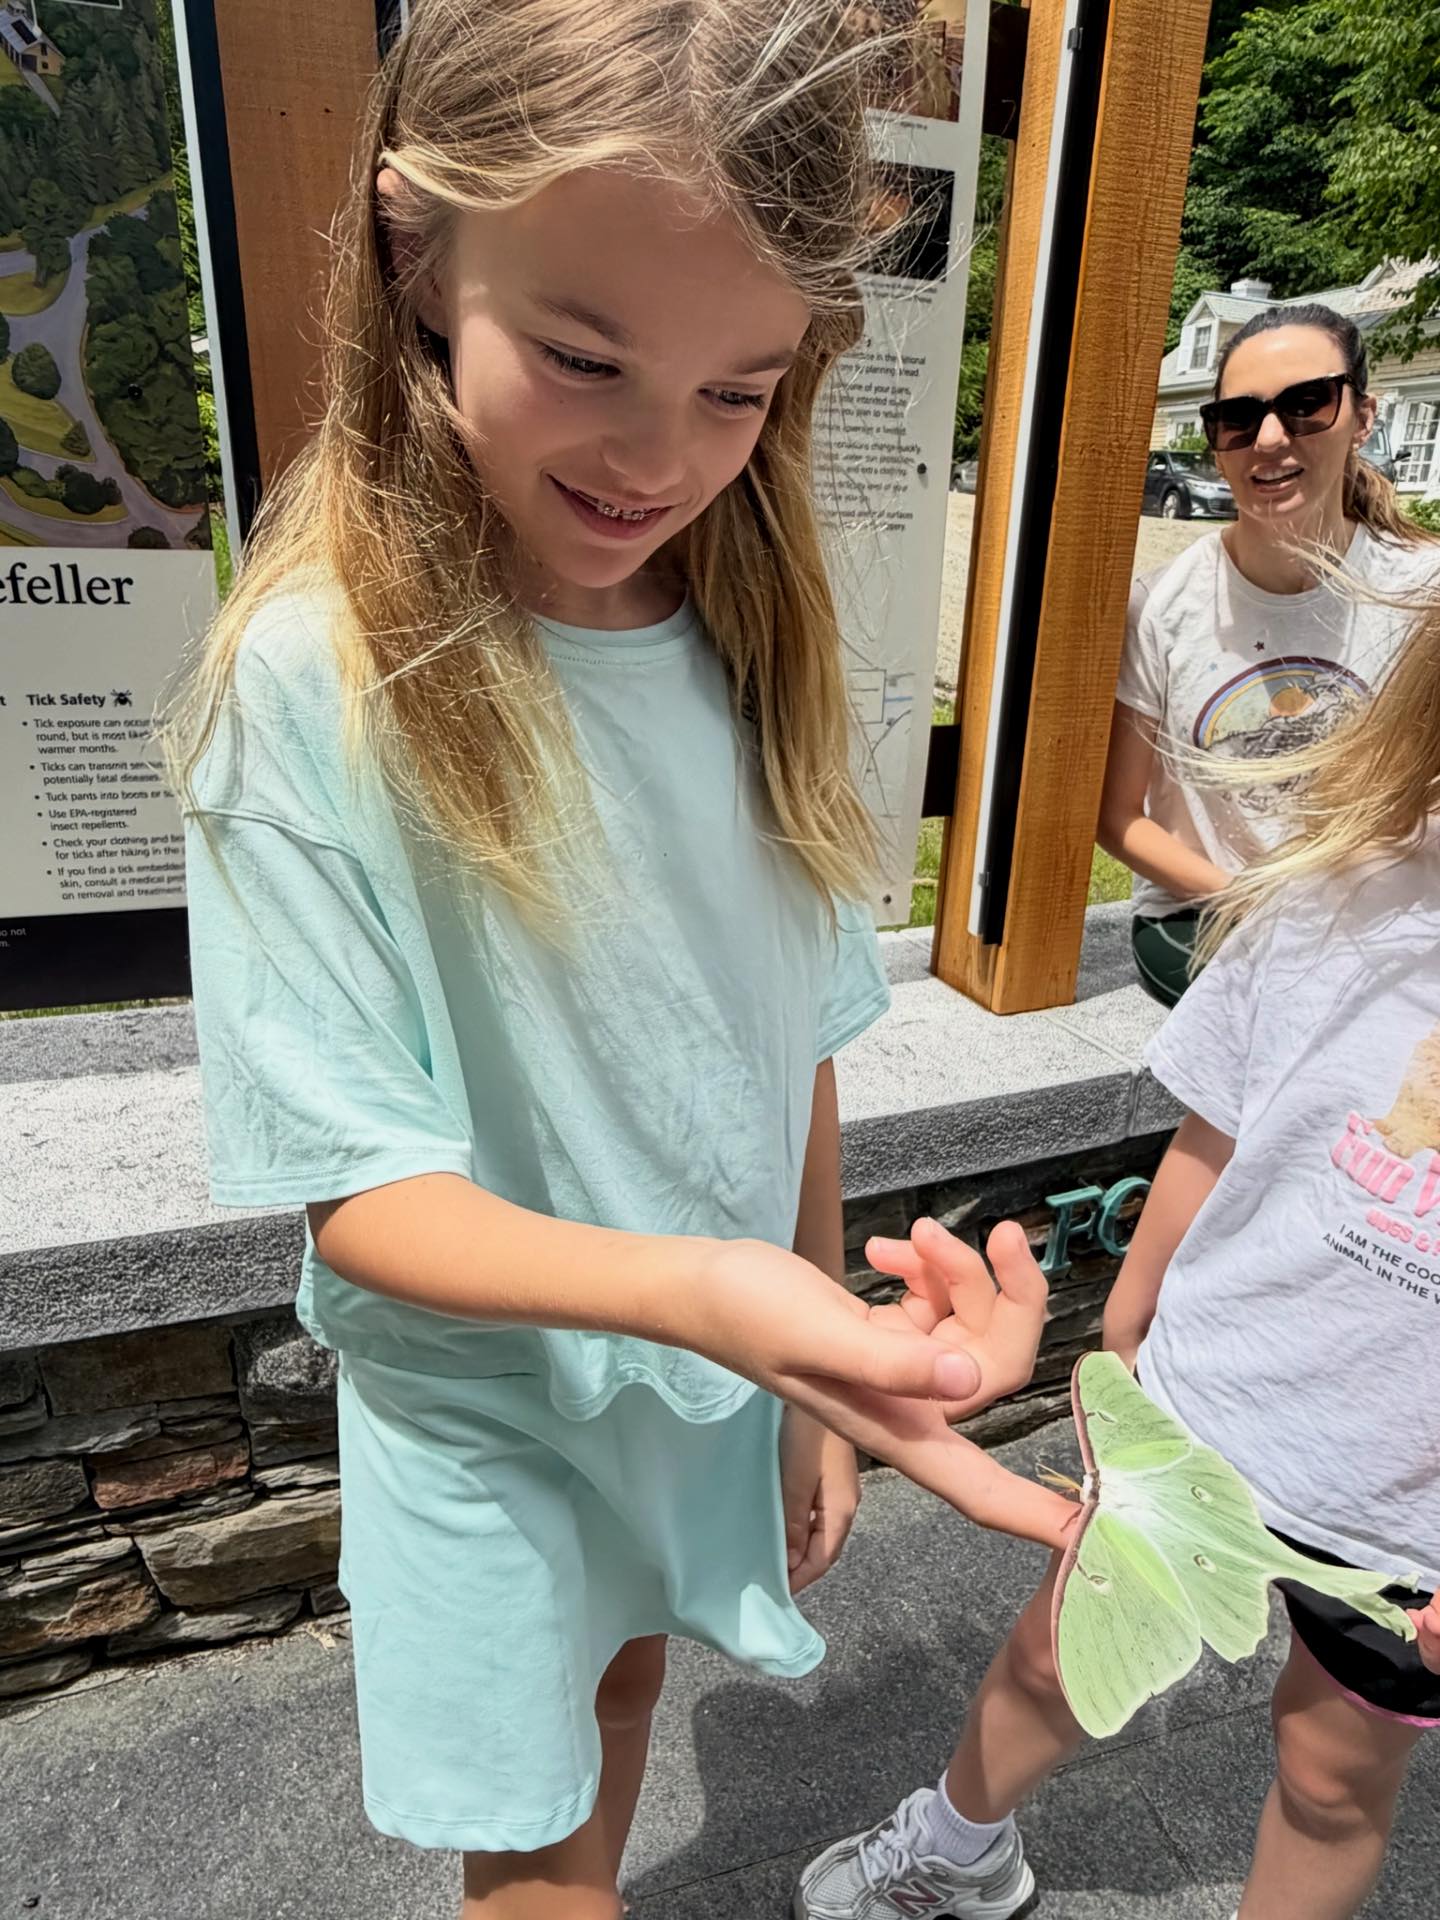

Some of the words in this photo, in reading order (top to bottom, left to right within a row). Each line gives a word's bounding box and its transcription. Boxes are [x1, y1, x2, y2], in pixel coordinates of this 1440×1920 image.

[0, 561, 134, 605] feller
[25, 693, 57, 706] Tick
[60, 692, 106, 708] Safety
[33, 718, 55, 728] Tick
[57, 719, 101, 730] exposure
[103, 719, 121, 728] can
[36, 732, 69, 742] round,
[71, 731, 89, 741] but
[91, 732, 100, 740] is
[38, 745, 76, 754] warmer
[40, 762, 66, 772] Ticks
[68, 763, 86, 771] can
[43, 774, 94, 787] potentially
[45, 791, 68, 801] Tuck
[71, 791, 98, 803] pants
[48, 808, 67, 819] Use
[69, 806, 137, 818] EPA-registered
[50, 821, 79, 831] insect
[53, 837, 84, 848] Check
[86, 838, 107, 849] your
[55, 850, 69, 860] for
[72, 849, 94, 860] ticks
[57, 866, 65, 876] If
[67, 868, 86, 878] you
[88, 865, 107, 875] find
[84, 877, 118, 888] consult
[62, 892, 75, 901] on
[77, 889, 114, 900] removal
[1339, 1223, 1347, 1234] I
[1345, 1229, 1368, 1249] AM
[1371, 1242, 1402, 1268] THE
[1322, 1232, 1373, 1272] ANIMAL
[1376, 1264, 1393, 1282] IN
[1396, 1274, 1430, 1300] THE
